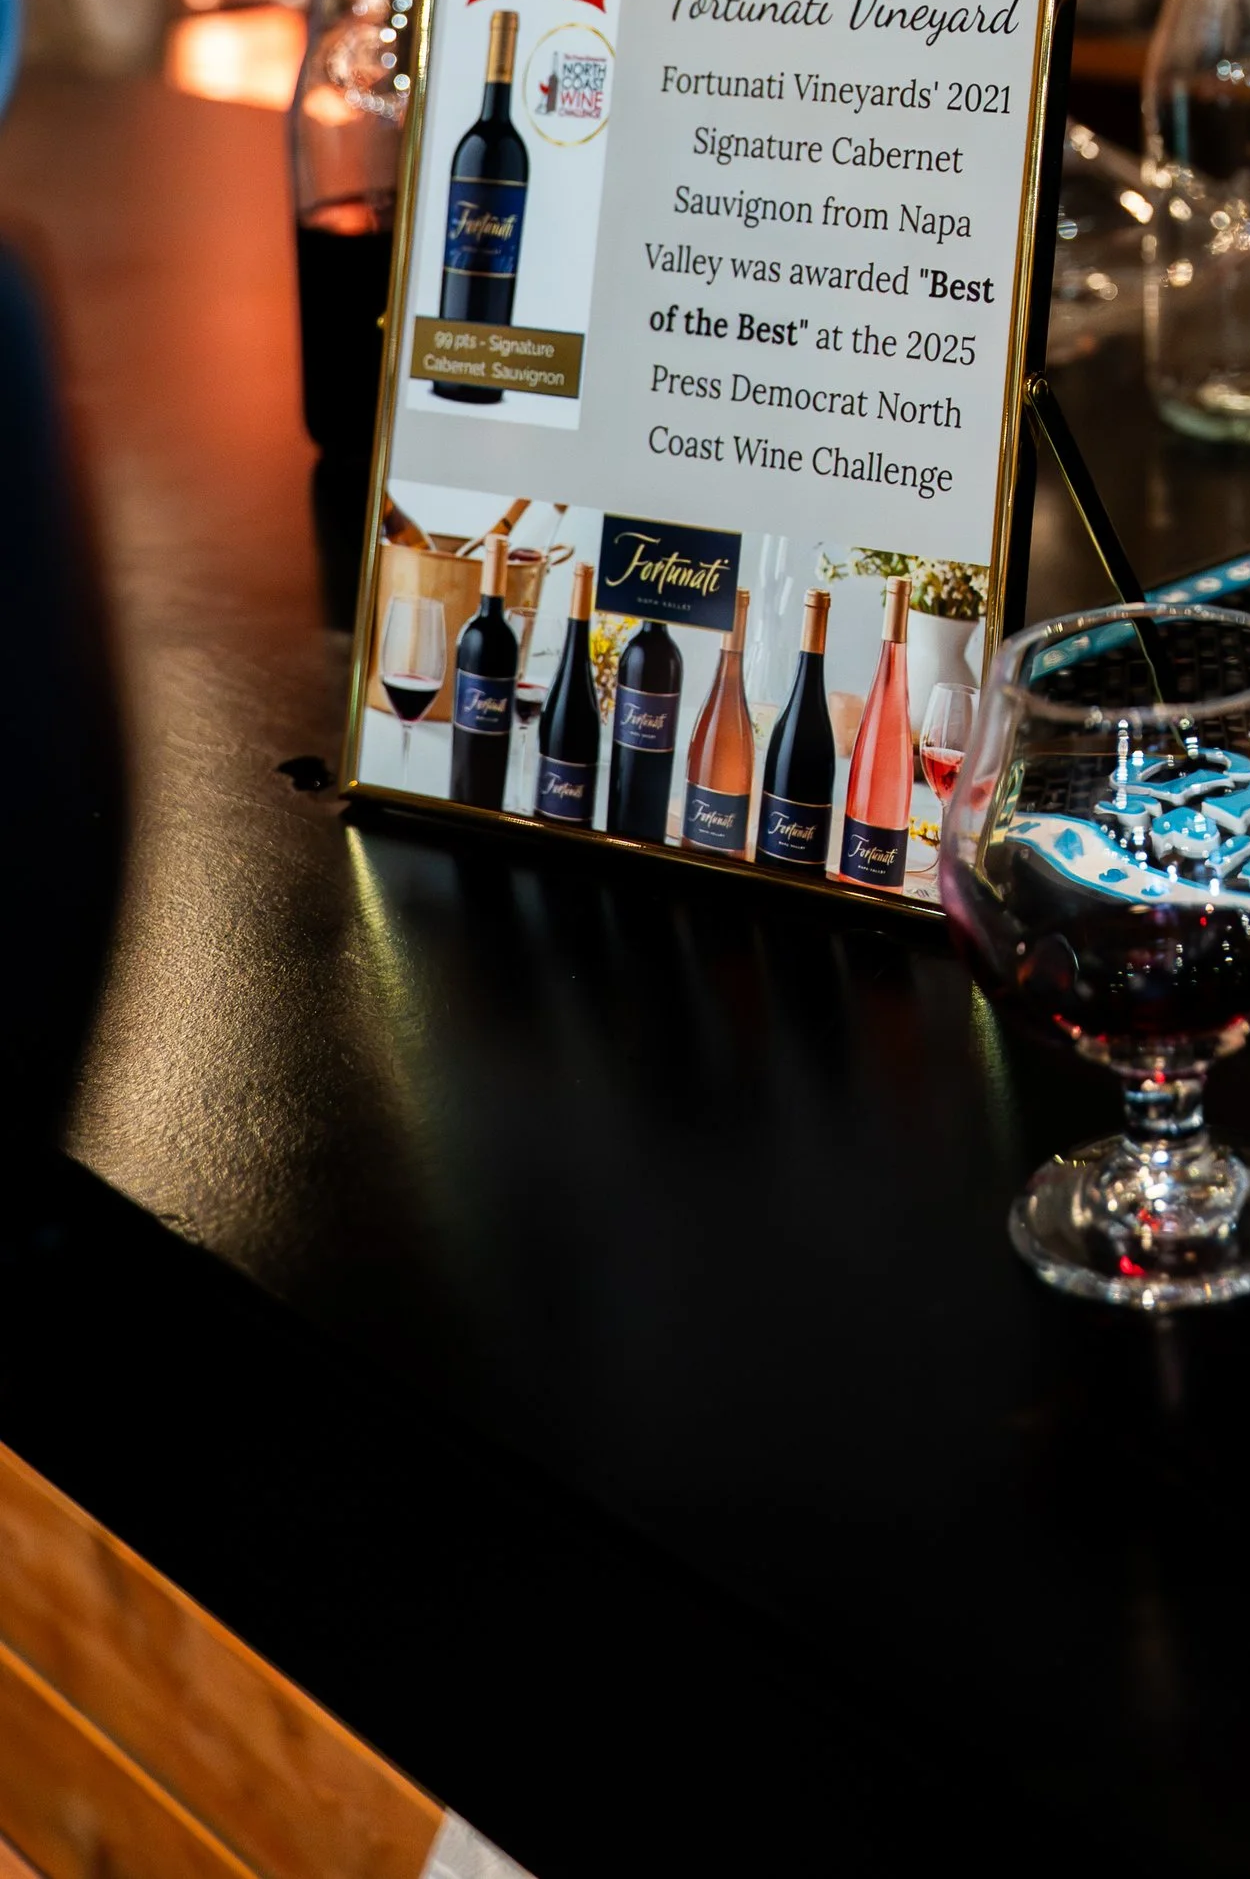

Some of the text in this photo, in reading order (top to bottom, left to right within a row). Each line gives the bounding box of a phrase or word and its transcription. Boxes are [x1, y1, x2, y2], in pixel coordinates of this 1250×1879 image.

[563, 62, 607, 79] NORTH
[660, 66, 1010, 114] Fortunati Vineyards' 2021
[560, 90, 603, 109] WINE
[693, 127, 963, 173] Signature Cabernet
[674, 186, 971, 243] Sauvignon from Napa
[644, 243, 995, 303] Valley was awarded "Best
[489, 334, 555, 358] Signature
[649, 305, 977, 365] of the Best" at the 2025
[423, 353, 565, 387] Cabernet Sauvignon
[650, 364, 962, 429] Press Democrat North
[648, 426, 953, 499] Coast Wine Challenge
[604, 531, 731, 597] Fortunati
[848, 834, 898, 866] Fortunati
